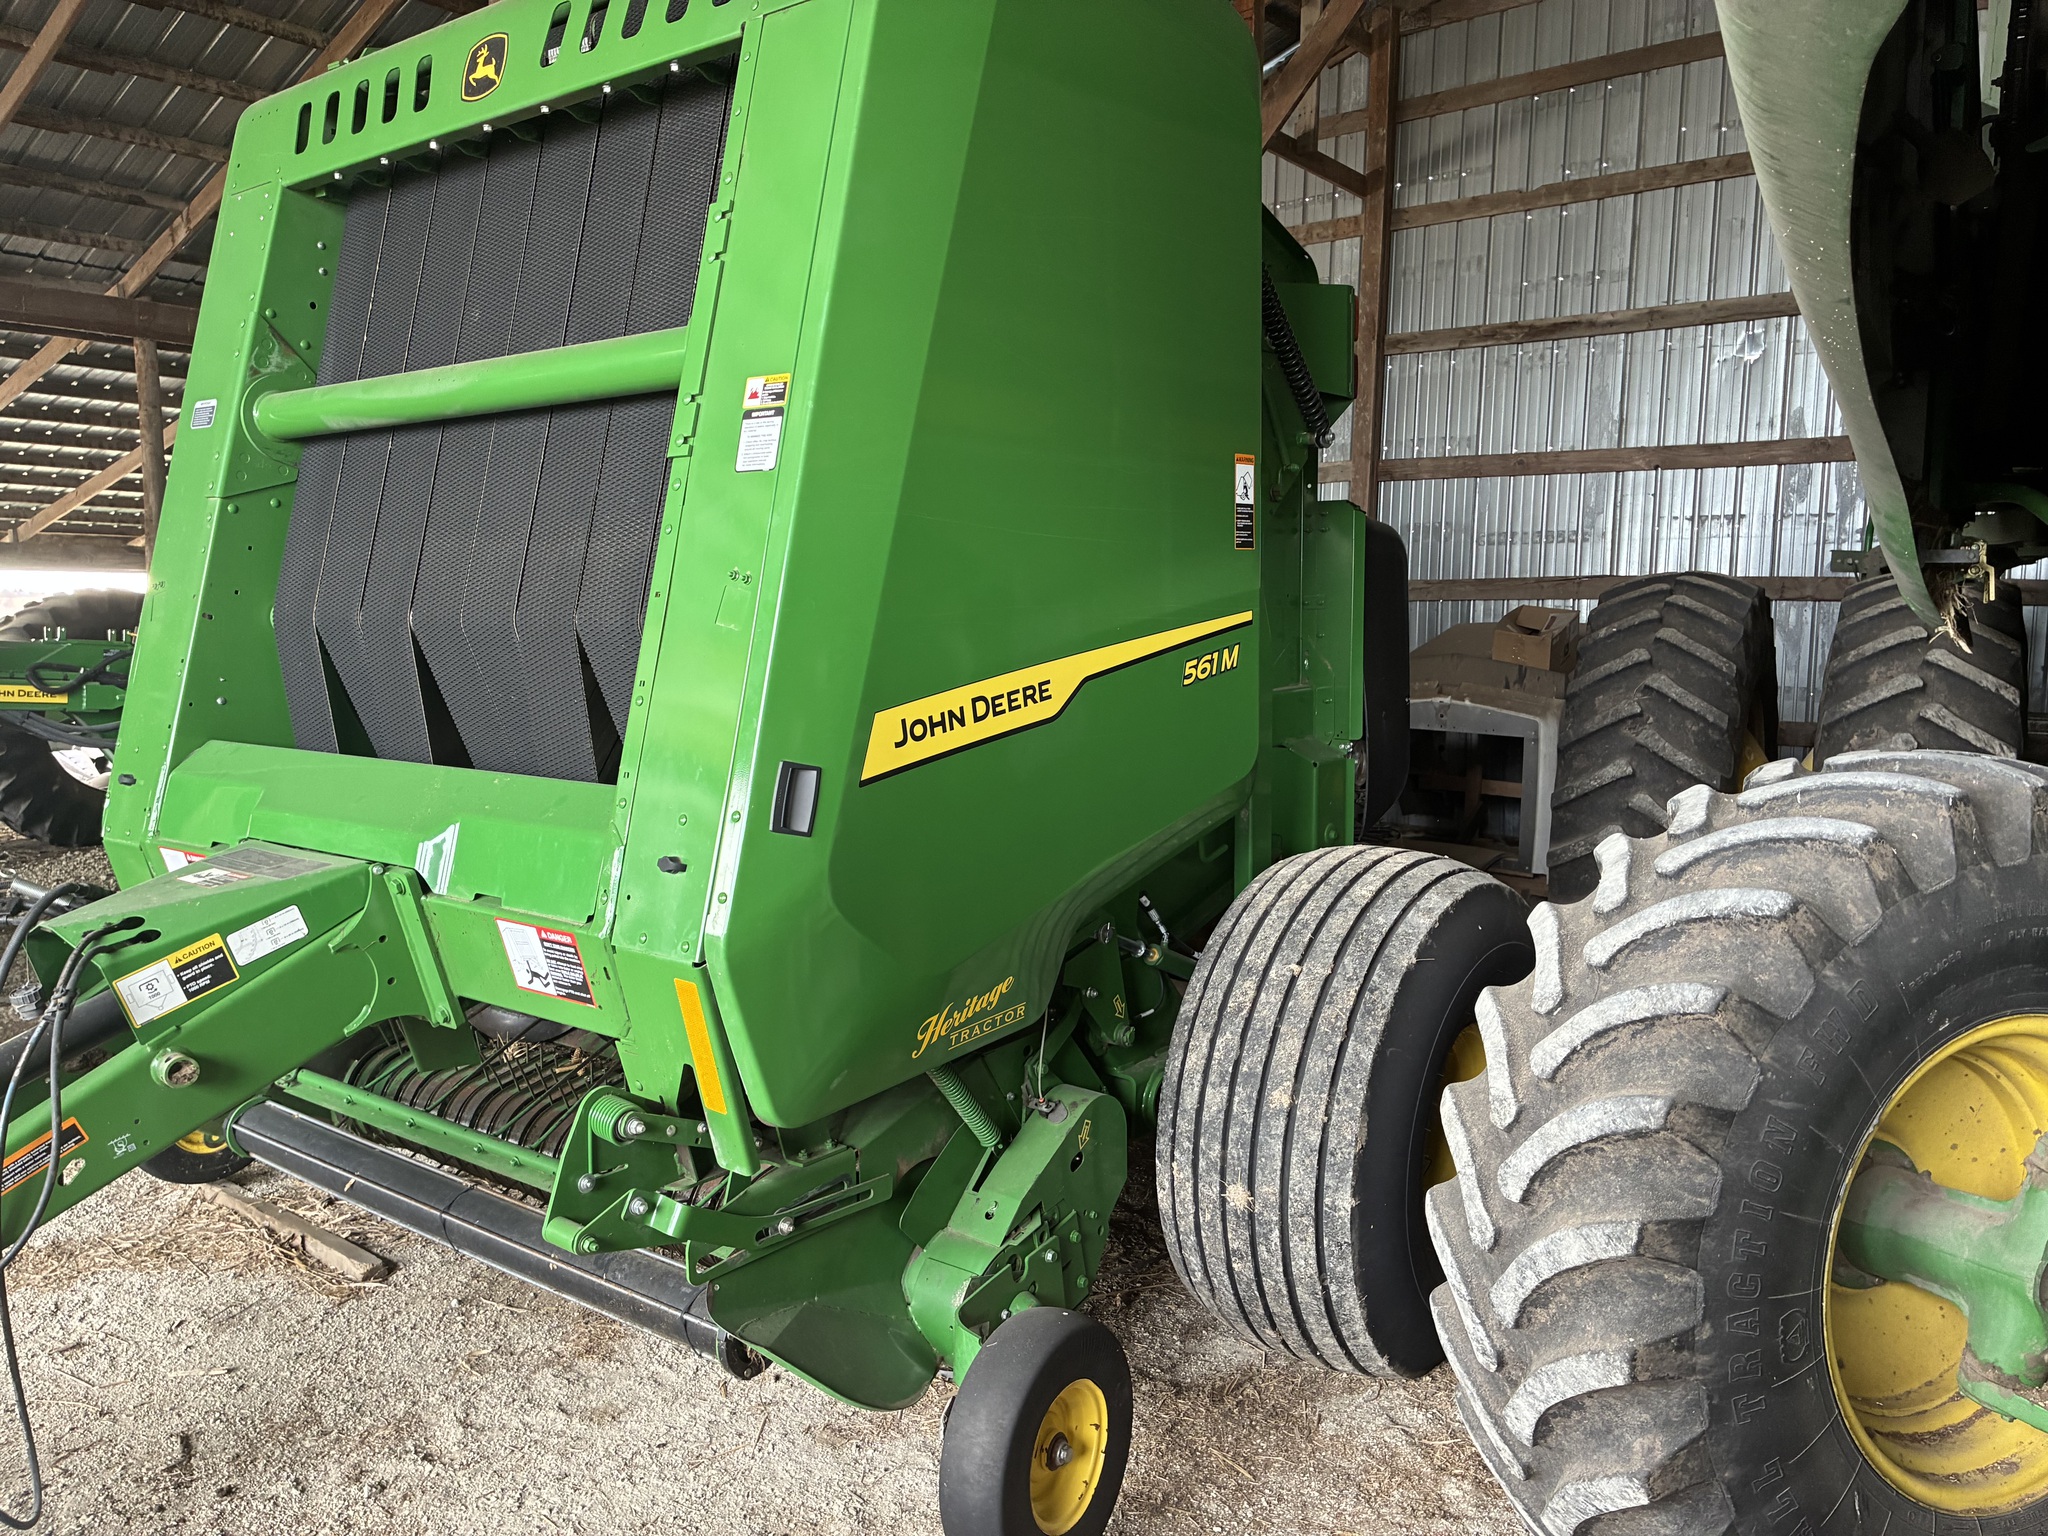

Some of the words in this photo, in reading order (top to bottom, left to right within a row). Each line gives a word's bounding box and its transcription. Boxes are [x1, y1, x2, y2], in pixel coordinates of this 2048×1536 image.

[17, 689, 57, 698] DEERE
[894, 705, 966, 749] JOHN
[970, 679, 1053, 724] DEERE
[182, 940, 216, 960] CAUTION
[546, 932, 572, 943] DANGER
[911, 976, 1015, 1059] Heritage
[949, 1005, 1026, 1046] TRACTOR
[1726, 1114, 1798, 1425] TRACTION
[1795, 979, 1879, 1087] FWD
